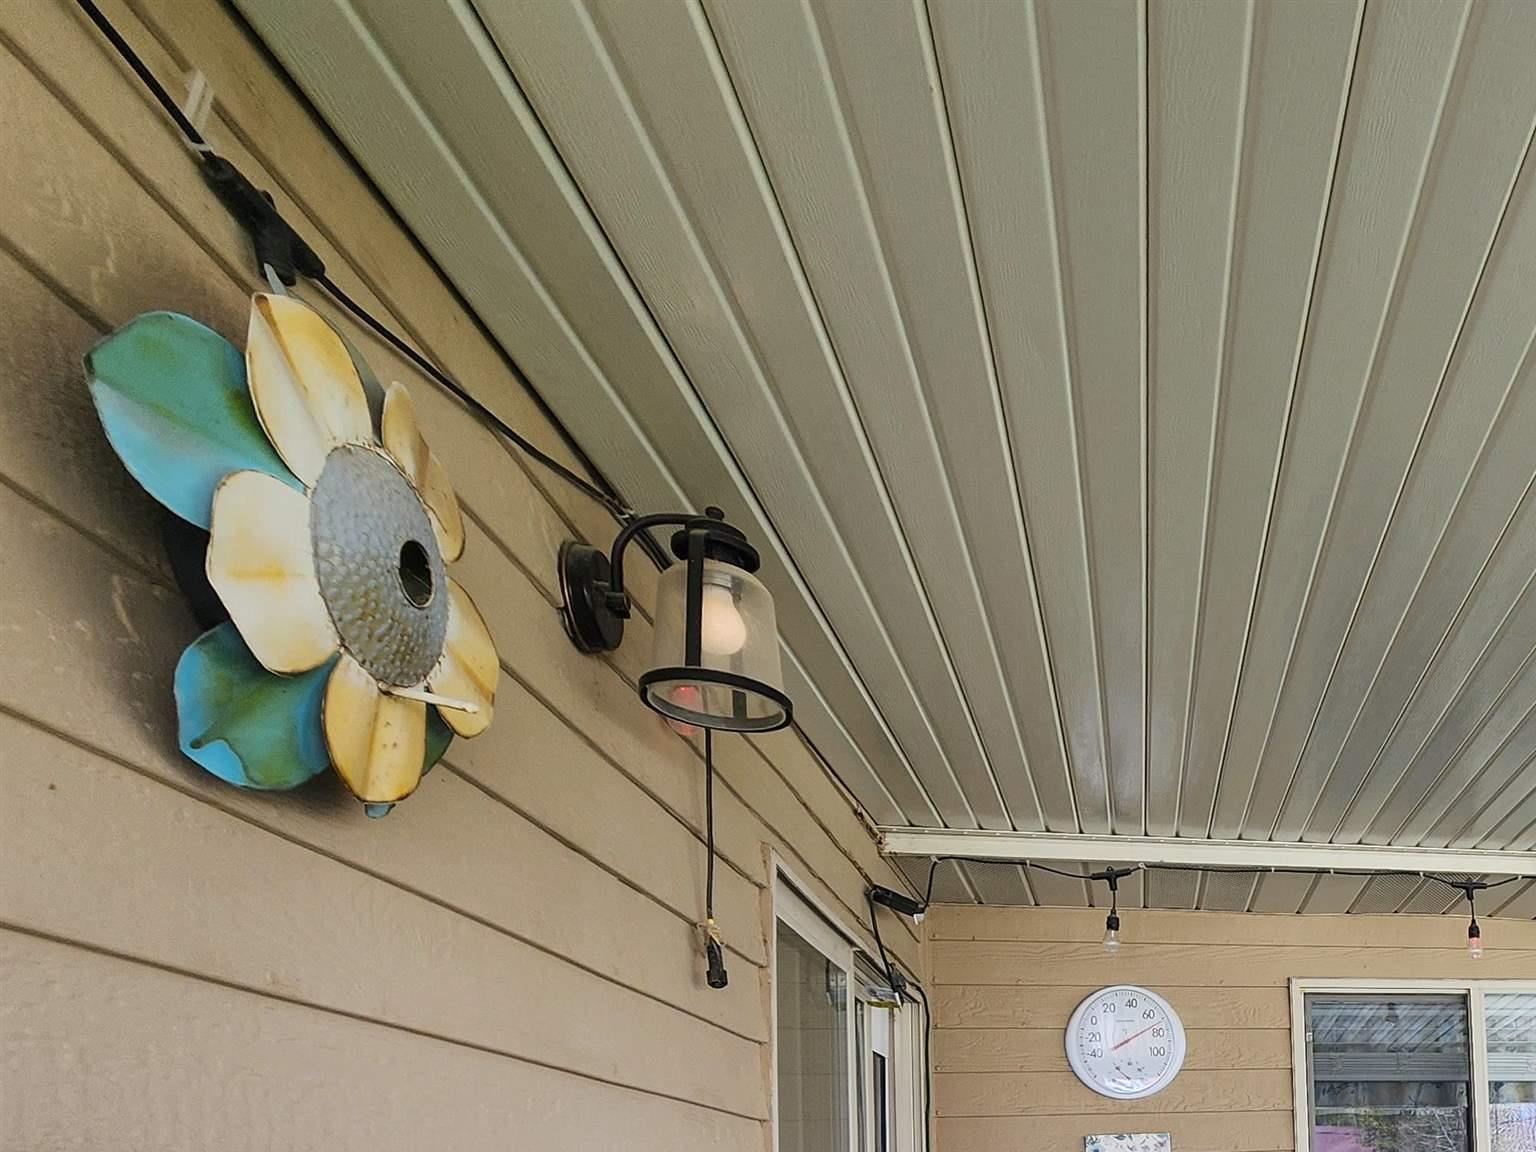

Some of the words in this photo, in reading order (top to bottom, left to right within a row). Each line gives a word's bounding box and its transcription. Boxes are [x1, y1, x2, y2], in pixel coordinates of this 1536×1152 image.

[1102, 1003, 1116, 1013] 20
[1125, 998, 1137, 1008] 40
[1142, 1009, 1155, 1019] 60
[1090, 1016, 1097, 1025] 0
[1152, 1027, 1164, 1038] 80
[1149, 1046, 1165, 1056] 100
